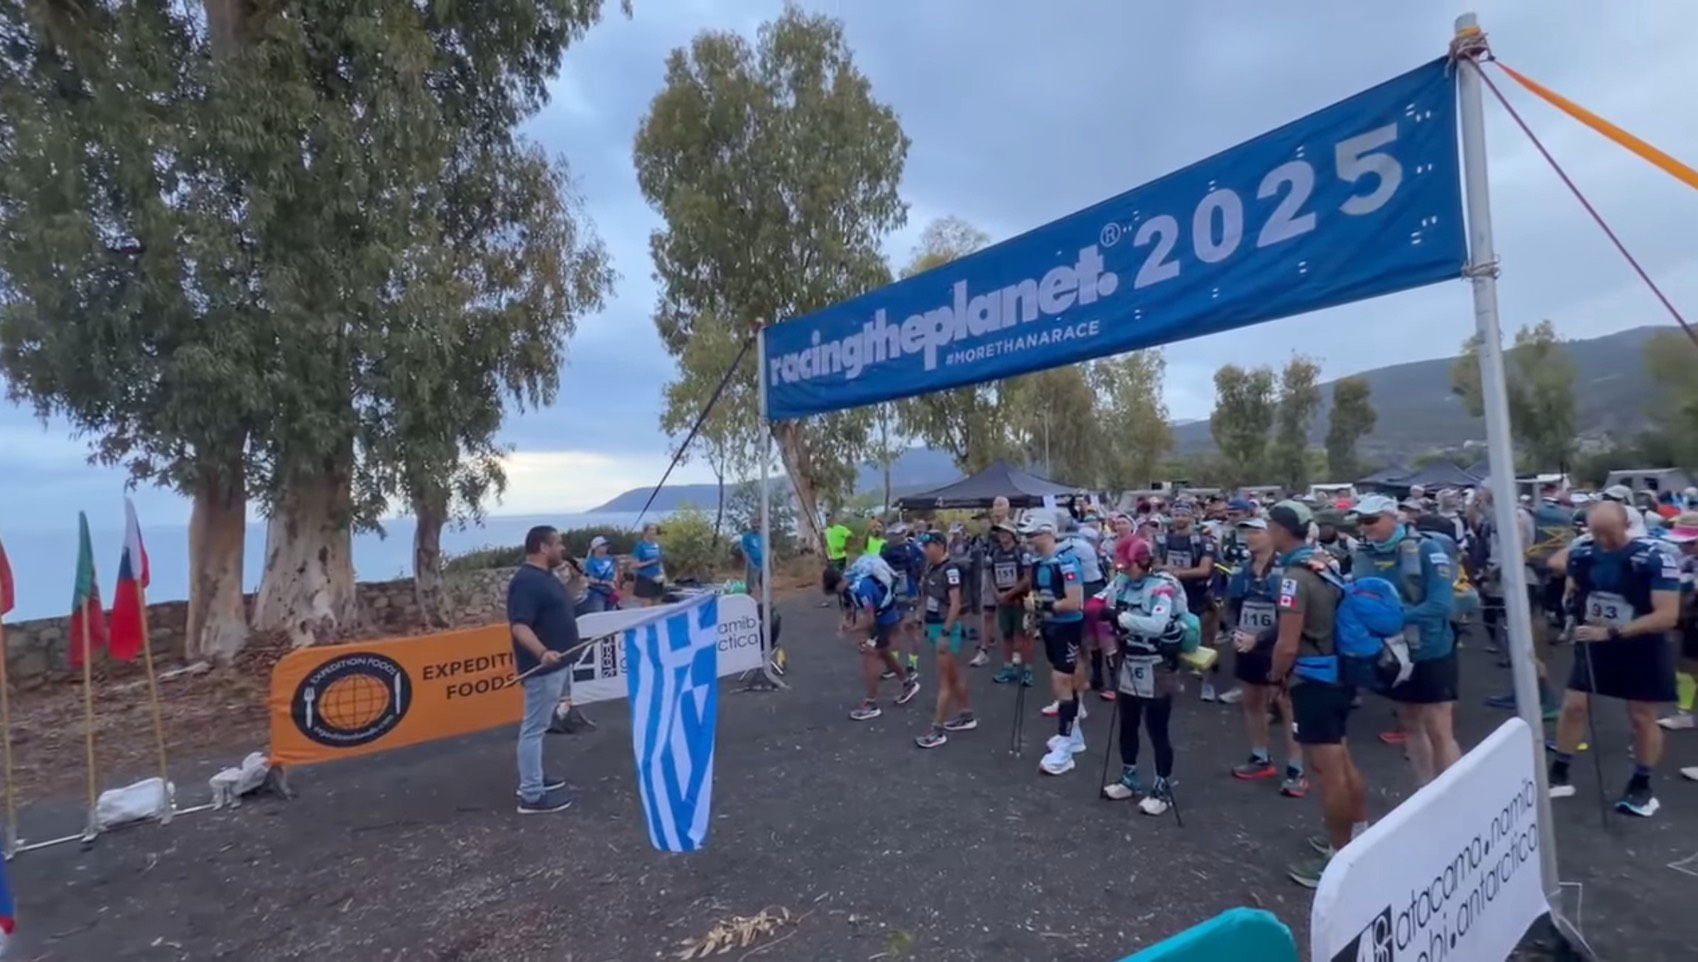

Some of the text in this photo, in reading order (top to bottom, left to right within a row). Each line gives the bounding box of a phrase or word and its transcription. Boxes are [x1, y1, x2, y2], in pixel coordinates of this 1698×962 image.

[1132, 122, 1403, 290] 2025
[945, 320, 1100, 367] #MORETHANARACE
[1243, 611, 1272, 627] 116
[422, 652, 514, 681] EXPEDITI
